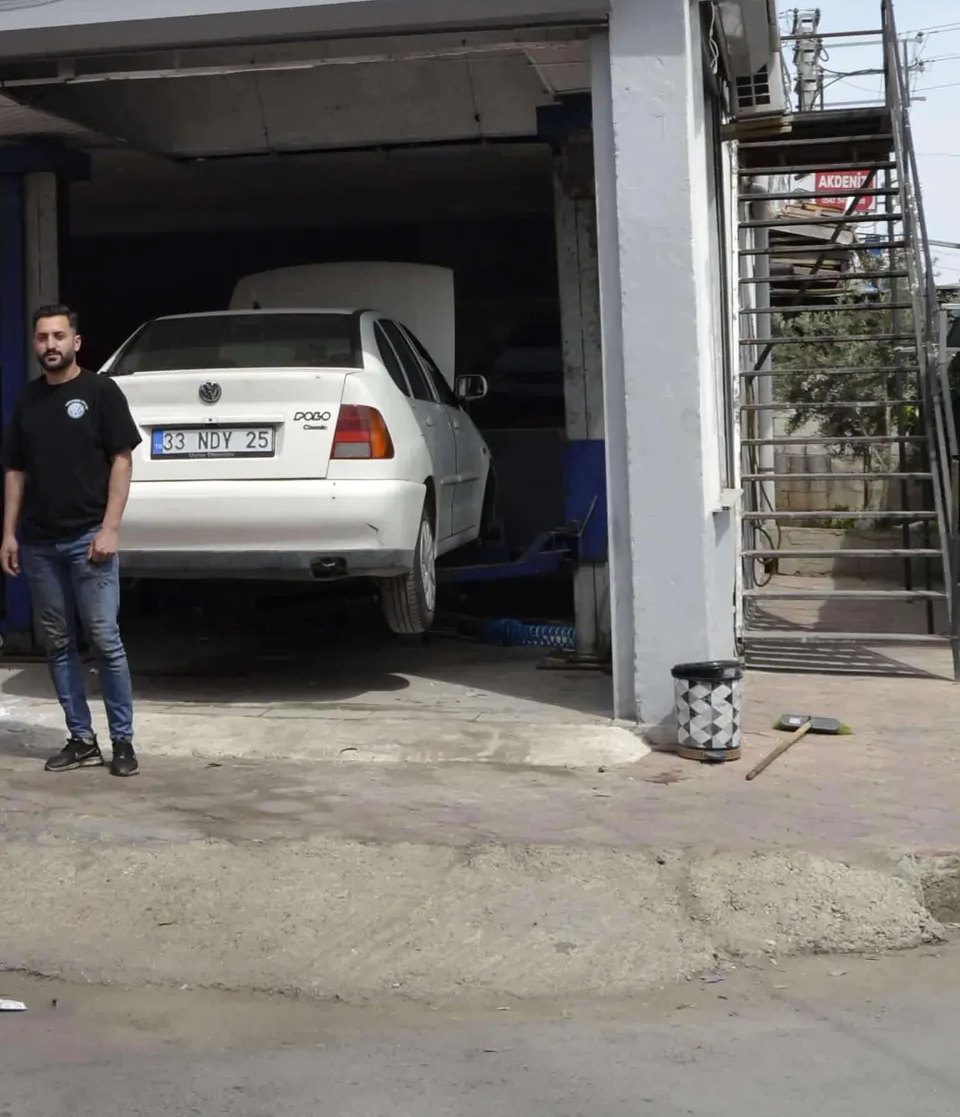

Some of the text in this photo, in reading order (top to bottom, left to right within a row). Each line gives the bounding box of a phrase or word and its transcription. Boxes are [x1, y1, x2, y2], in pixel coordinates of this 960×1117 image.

[293, 411, 331, 421] POLO
[163, 433, 185, 450] 33
[198, 431, 233, 450] NDY
[246, 431, 269, 449] 25
